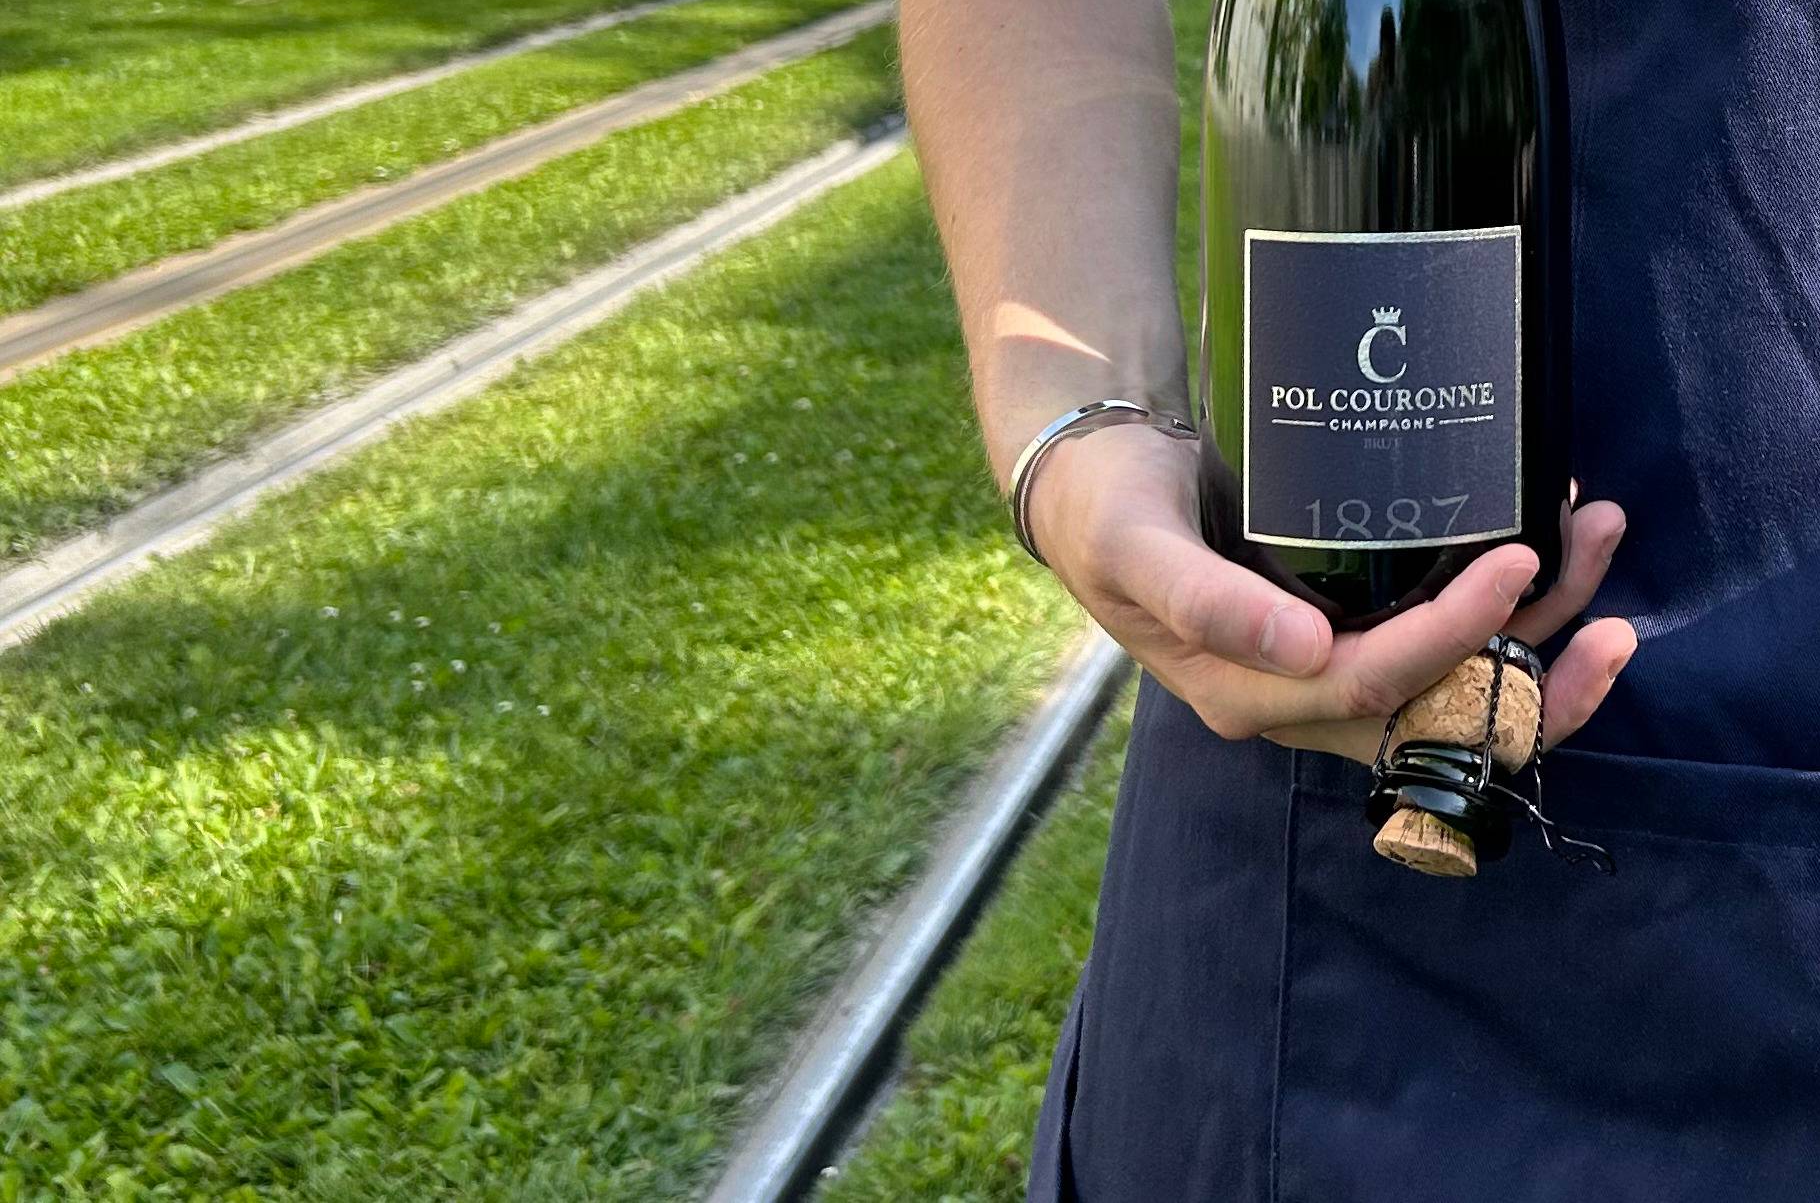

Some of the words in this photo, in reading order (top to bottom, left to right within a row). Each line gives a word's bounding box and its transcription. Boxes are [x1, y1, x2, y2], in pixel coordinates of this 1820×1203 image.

[1357, 324, 1408, 384] C
[1271, 385, 1323, 411] POL
[1329, 382, 1495, 412] COURONNE
[1328, 417, 1435, 432] CHAMPAGNE
[1304, 494, 1470, 539] 1887
